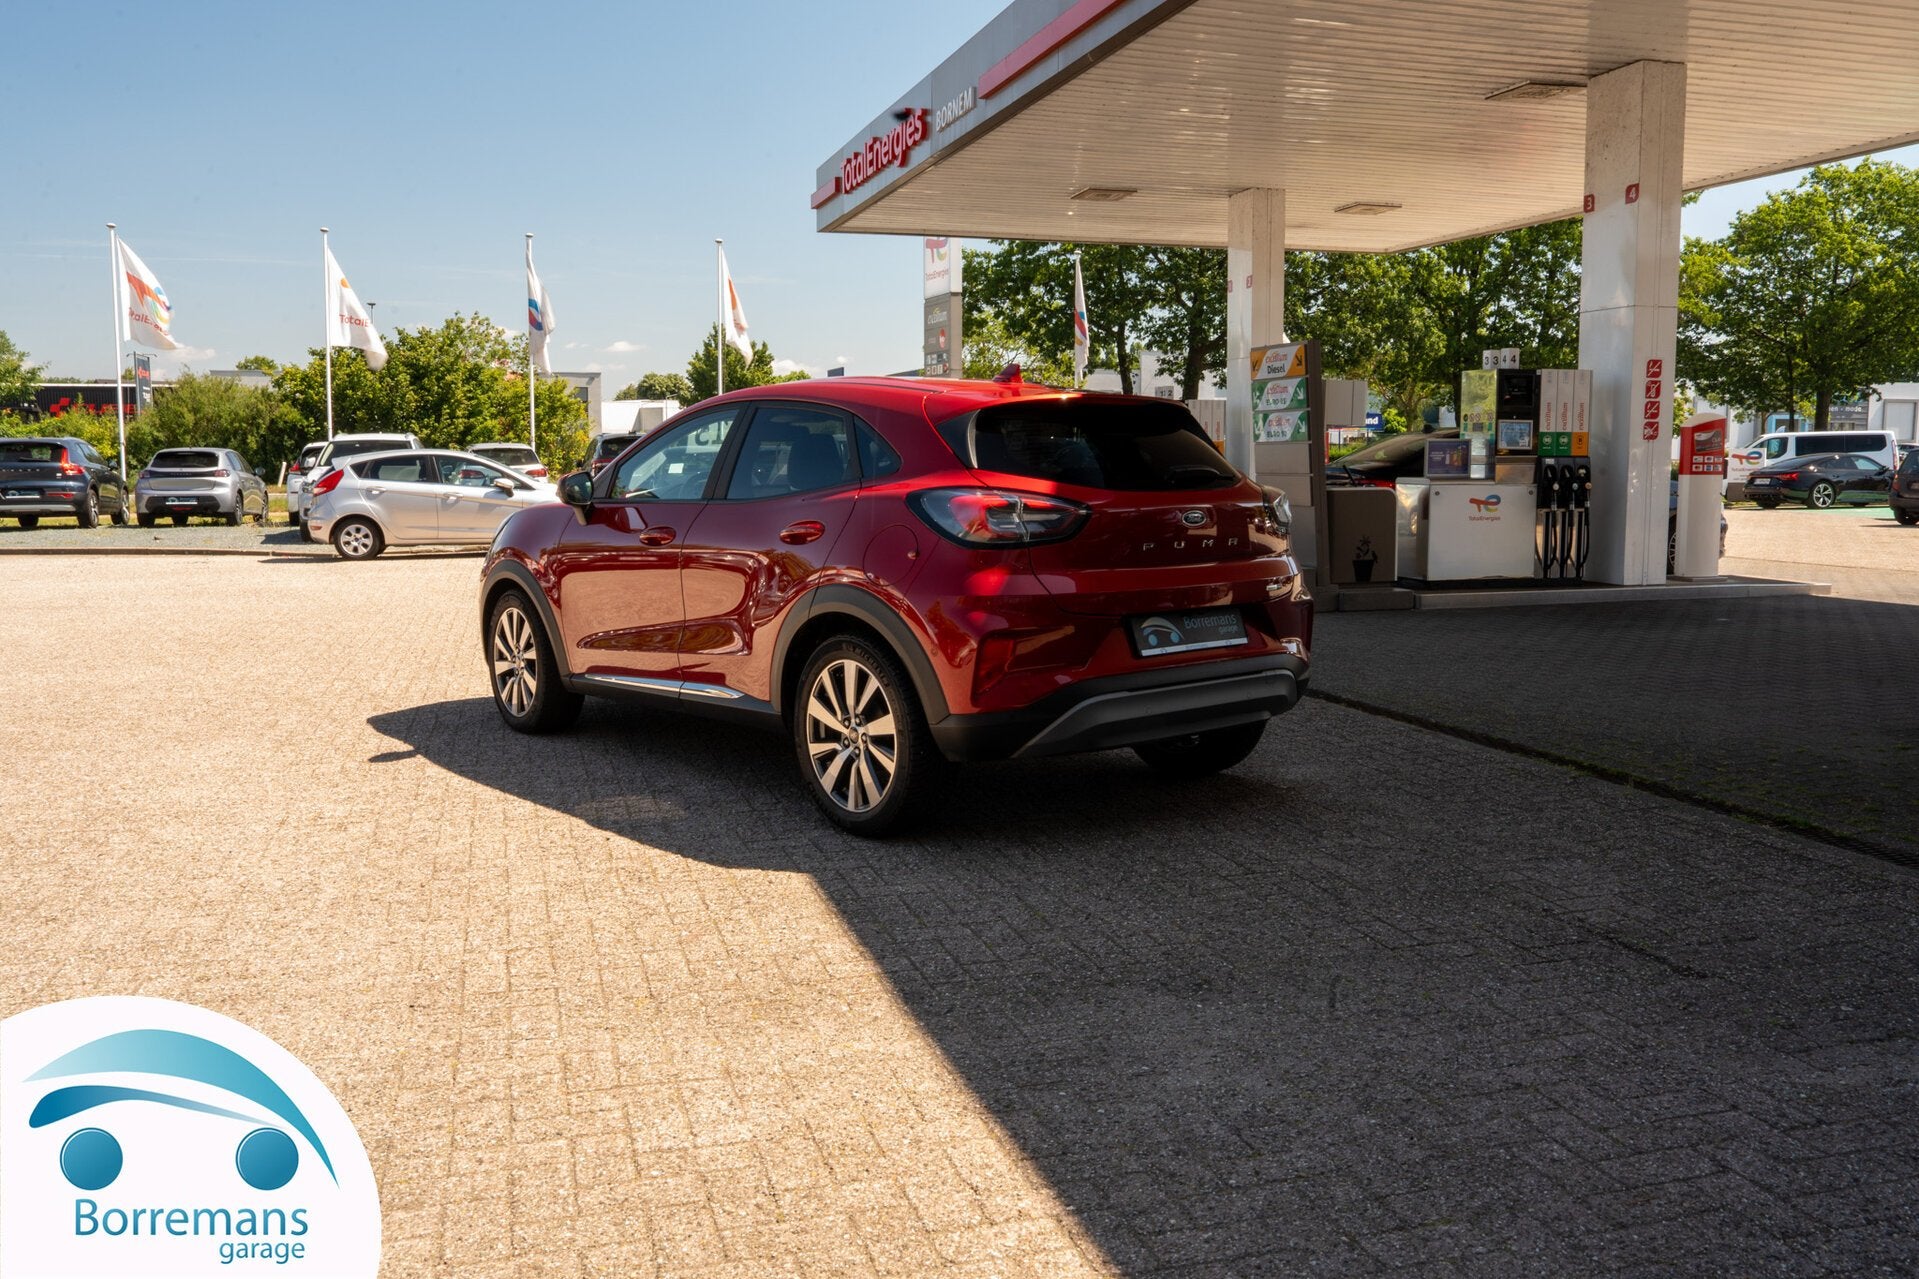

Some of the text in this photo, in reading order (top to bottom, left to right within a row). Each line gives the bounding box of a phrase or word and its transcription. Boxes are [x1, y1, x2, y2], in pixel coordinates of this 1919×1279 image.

[935, 86, 975, 132] BORNEM
[840, 108, 927, 193] TotalEnergies
[1484, 356, 1489, 366] 3
[1492, 355, 1499, 366] 3
[1502, 354, 1507, 364] 4
[1510, 354, 1516, 364] 4
[1267, 364, 1286, 374] Diesel
[1183, 613, 1237, 629] Borremans
[1218, 624, 1238, 635] garage
